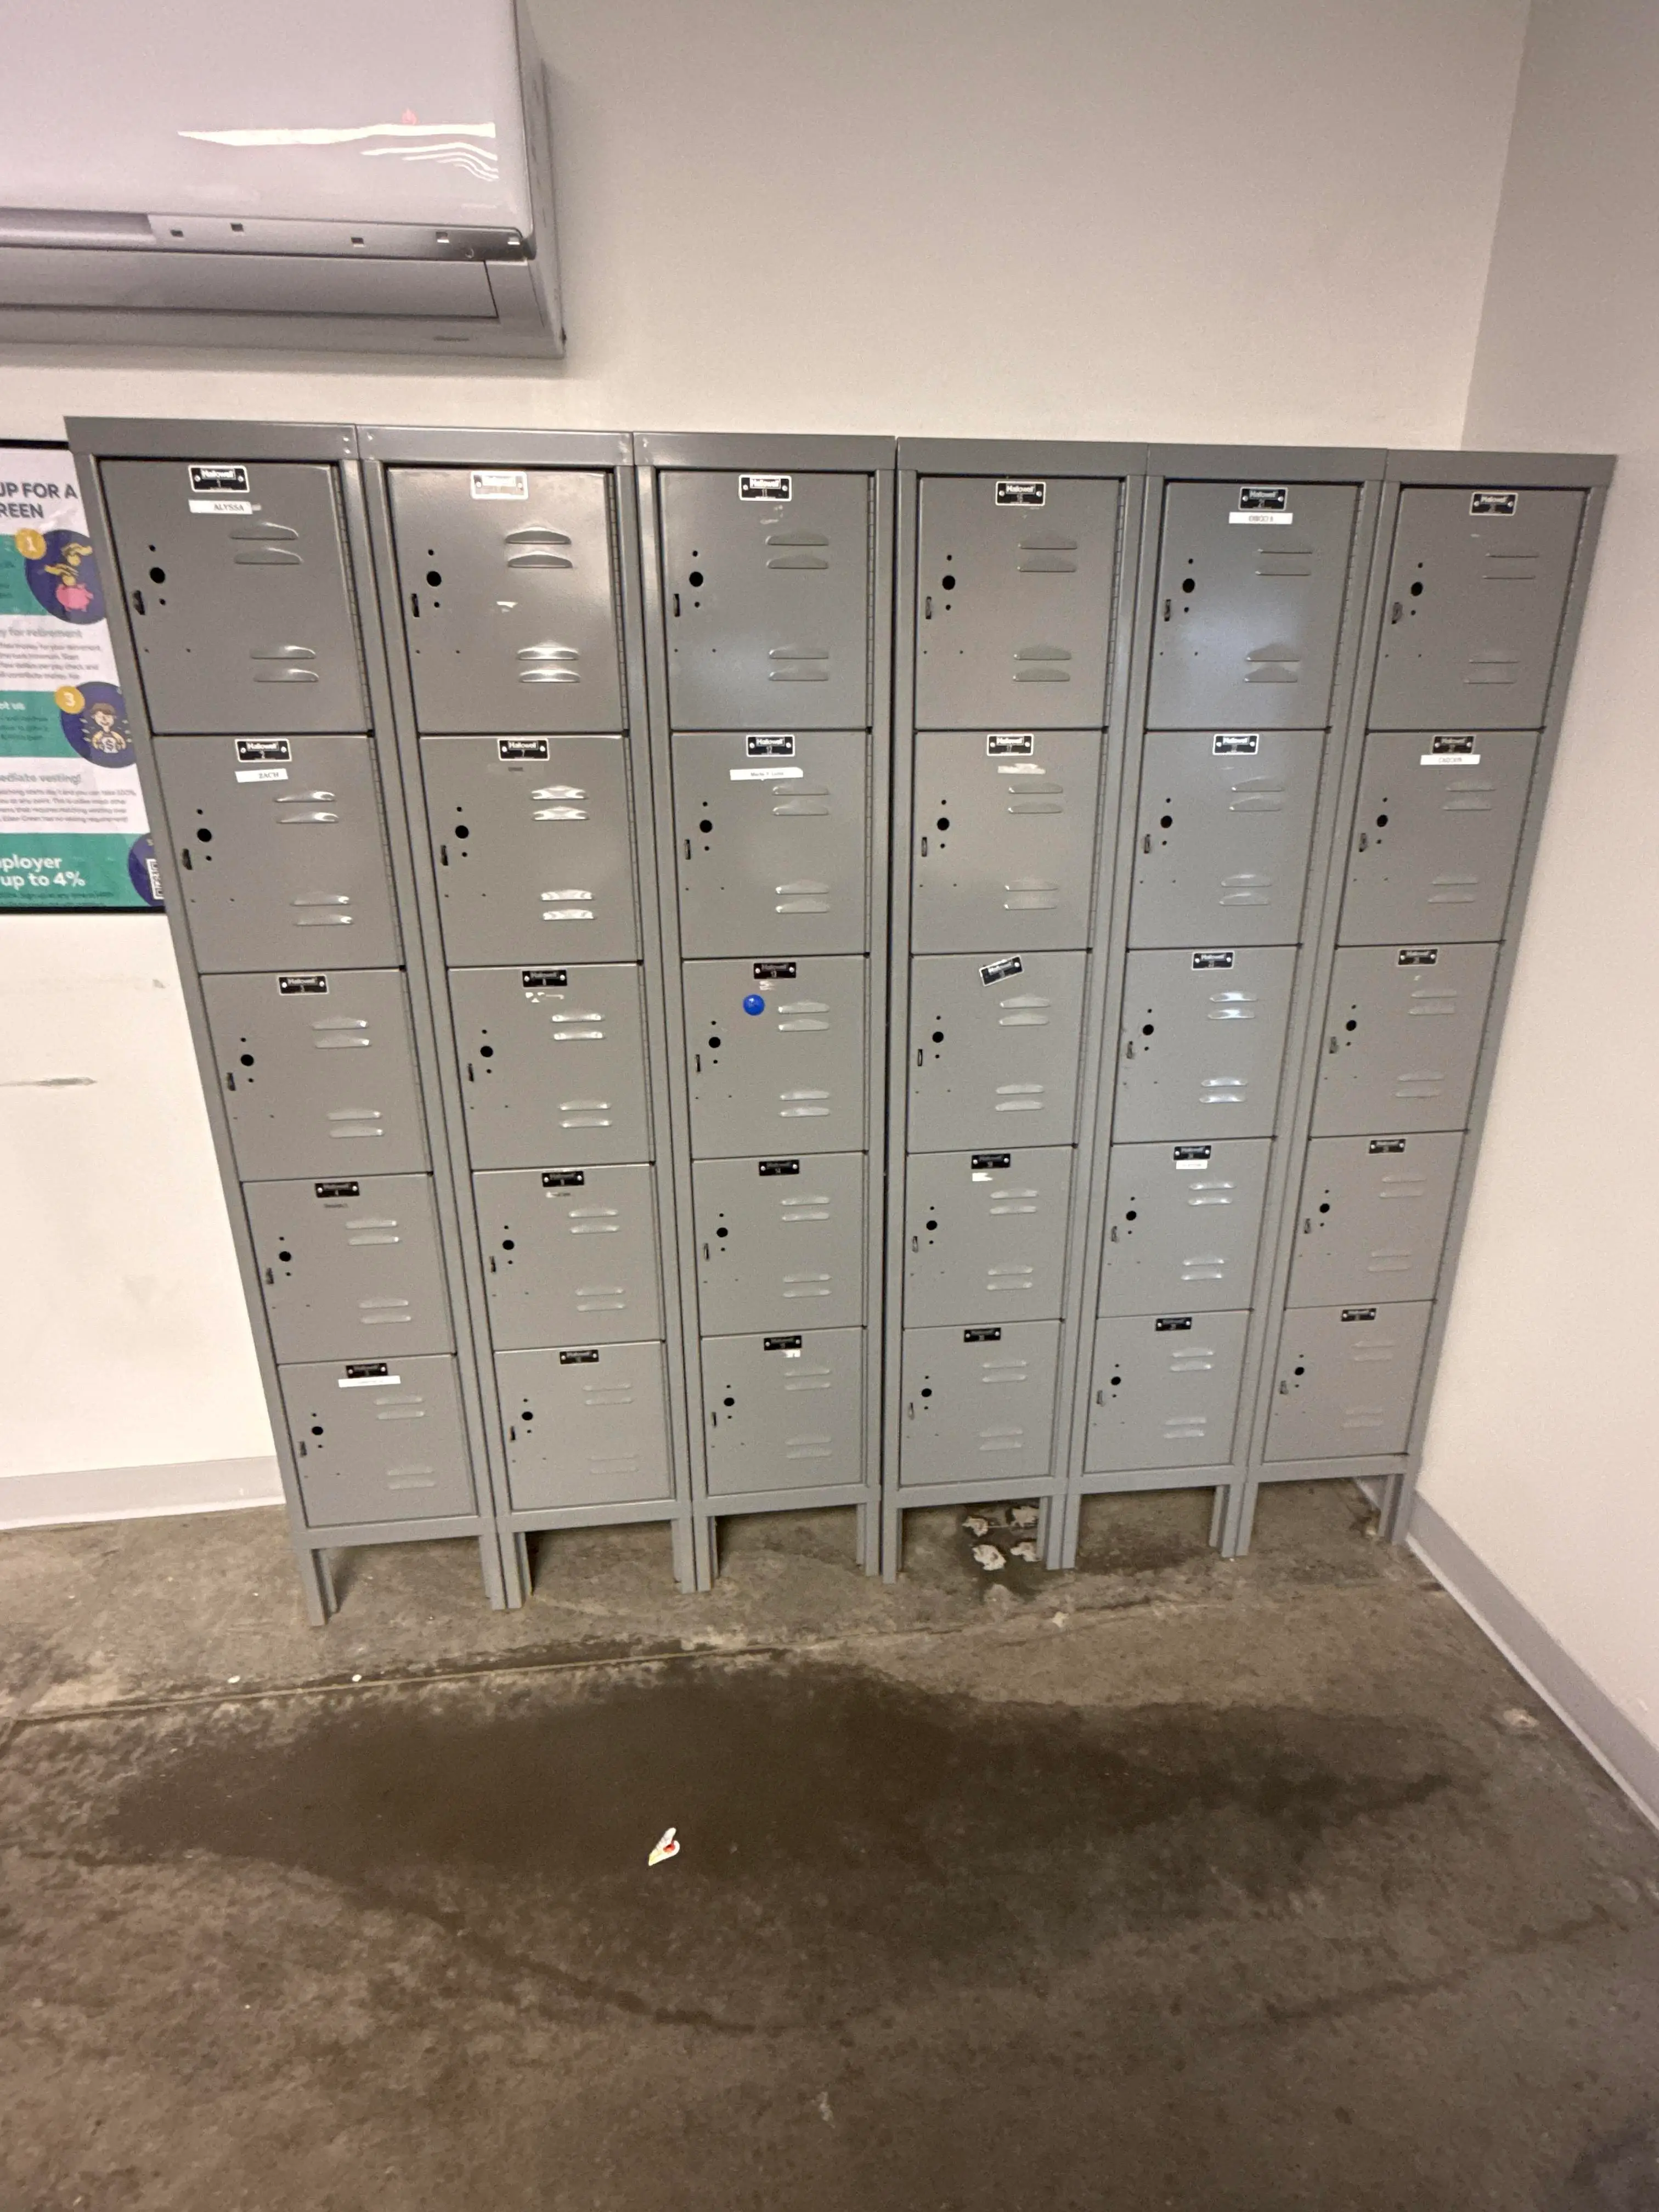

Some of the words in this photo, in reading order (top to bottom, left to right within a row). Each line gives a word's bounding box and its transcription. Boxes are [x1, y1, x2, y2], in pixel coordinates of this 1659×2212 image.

[200, 469, 235, 478] Hallowell
[751, 478, 780, 488] Hallowell
[22, 482, 61, 499] FOR
[64, 483, 78, 499] A
[1006, 484, 1035, 493] Hallowell
[214, 503, 244, 511] ALYSSA
[508, 741, 537, 749] Hallowell
[0, 772, 37, 782] ediate
[0, 853, 62, 873] ployer
[1, 875, 25, 891] up
[28, 872, 50, 887] to
[53, 871, 86, 887] 4%
